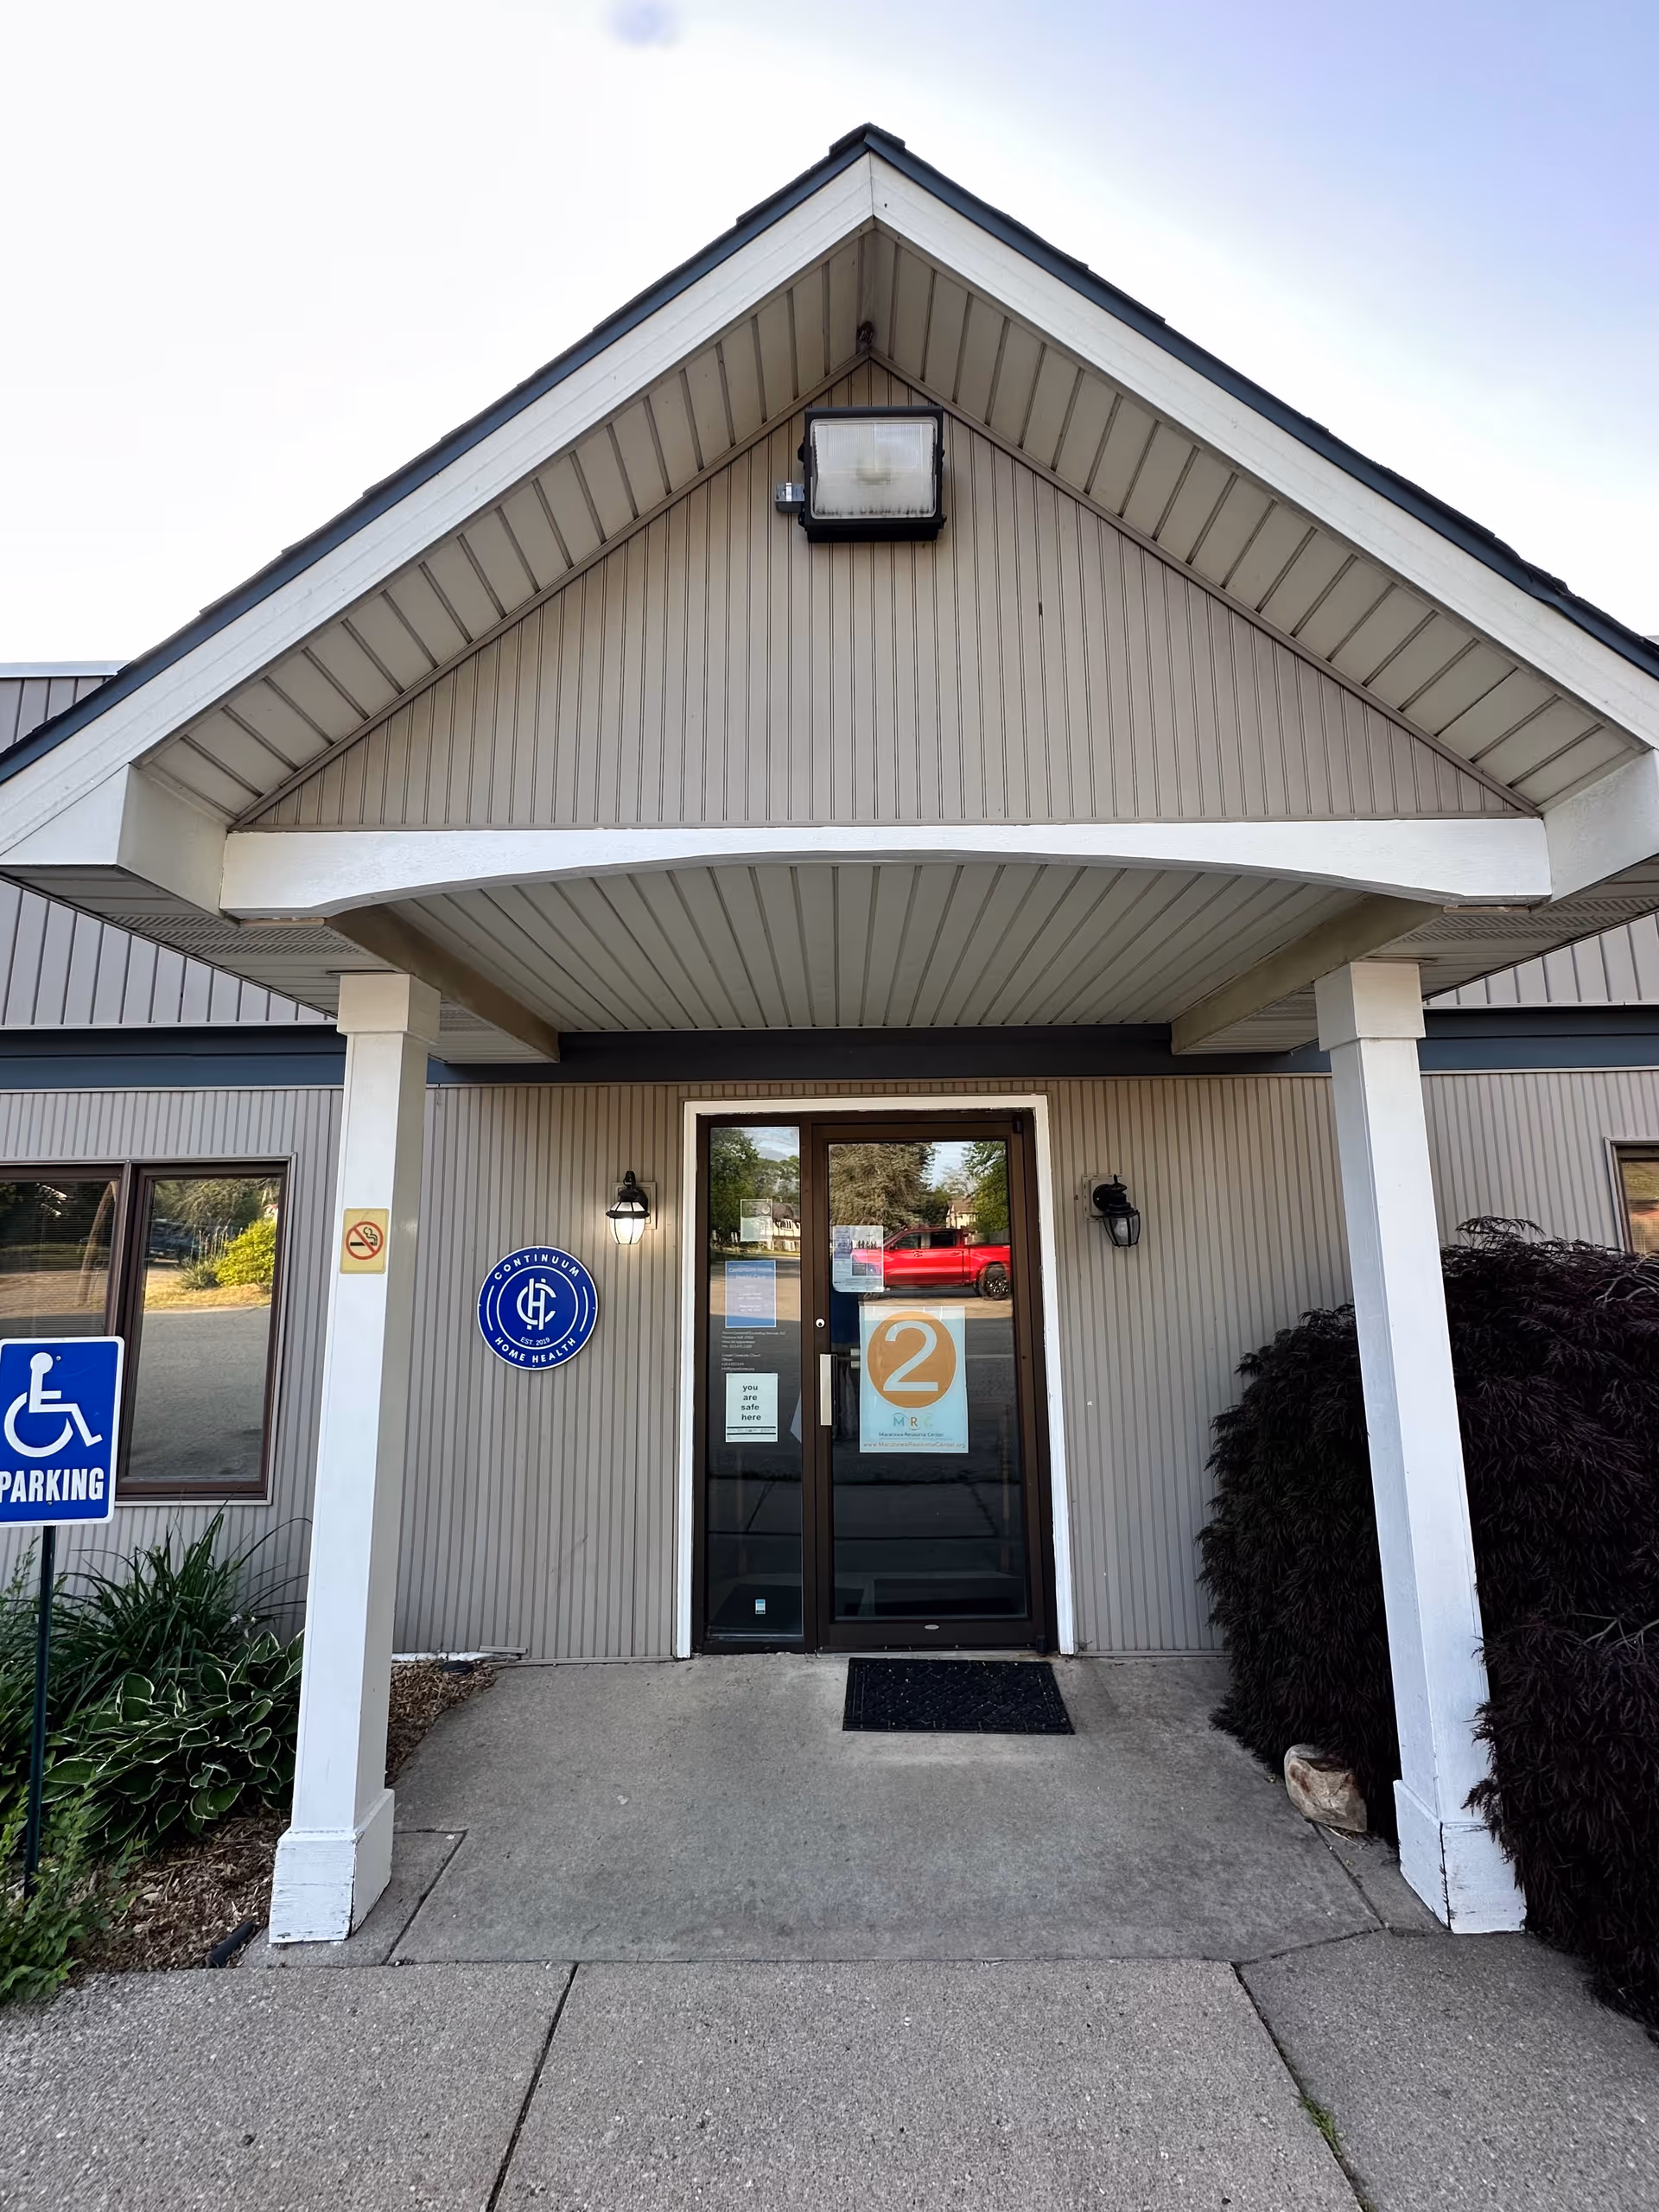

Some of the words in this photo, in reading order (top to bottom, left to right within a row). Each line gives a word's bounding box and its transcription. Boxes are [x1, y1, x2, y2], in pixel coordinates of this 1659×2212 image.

[494, 1254, 580, 1281] CONTINUUM
[494, 1337, 526, 1362] HOME
[531, 1338, 576, 1363] HEALTH
[520, 1336, 535, 1346] EST.
[536, 1337, 550, 1346] 2019
[883, 1320, 938, 1392] 2
[0, 1467, 105, 1503] PARKING
